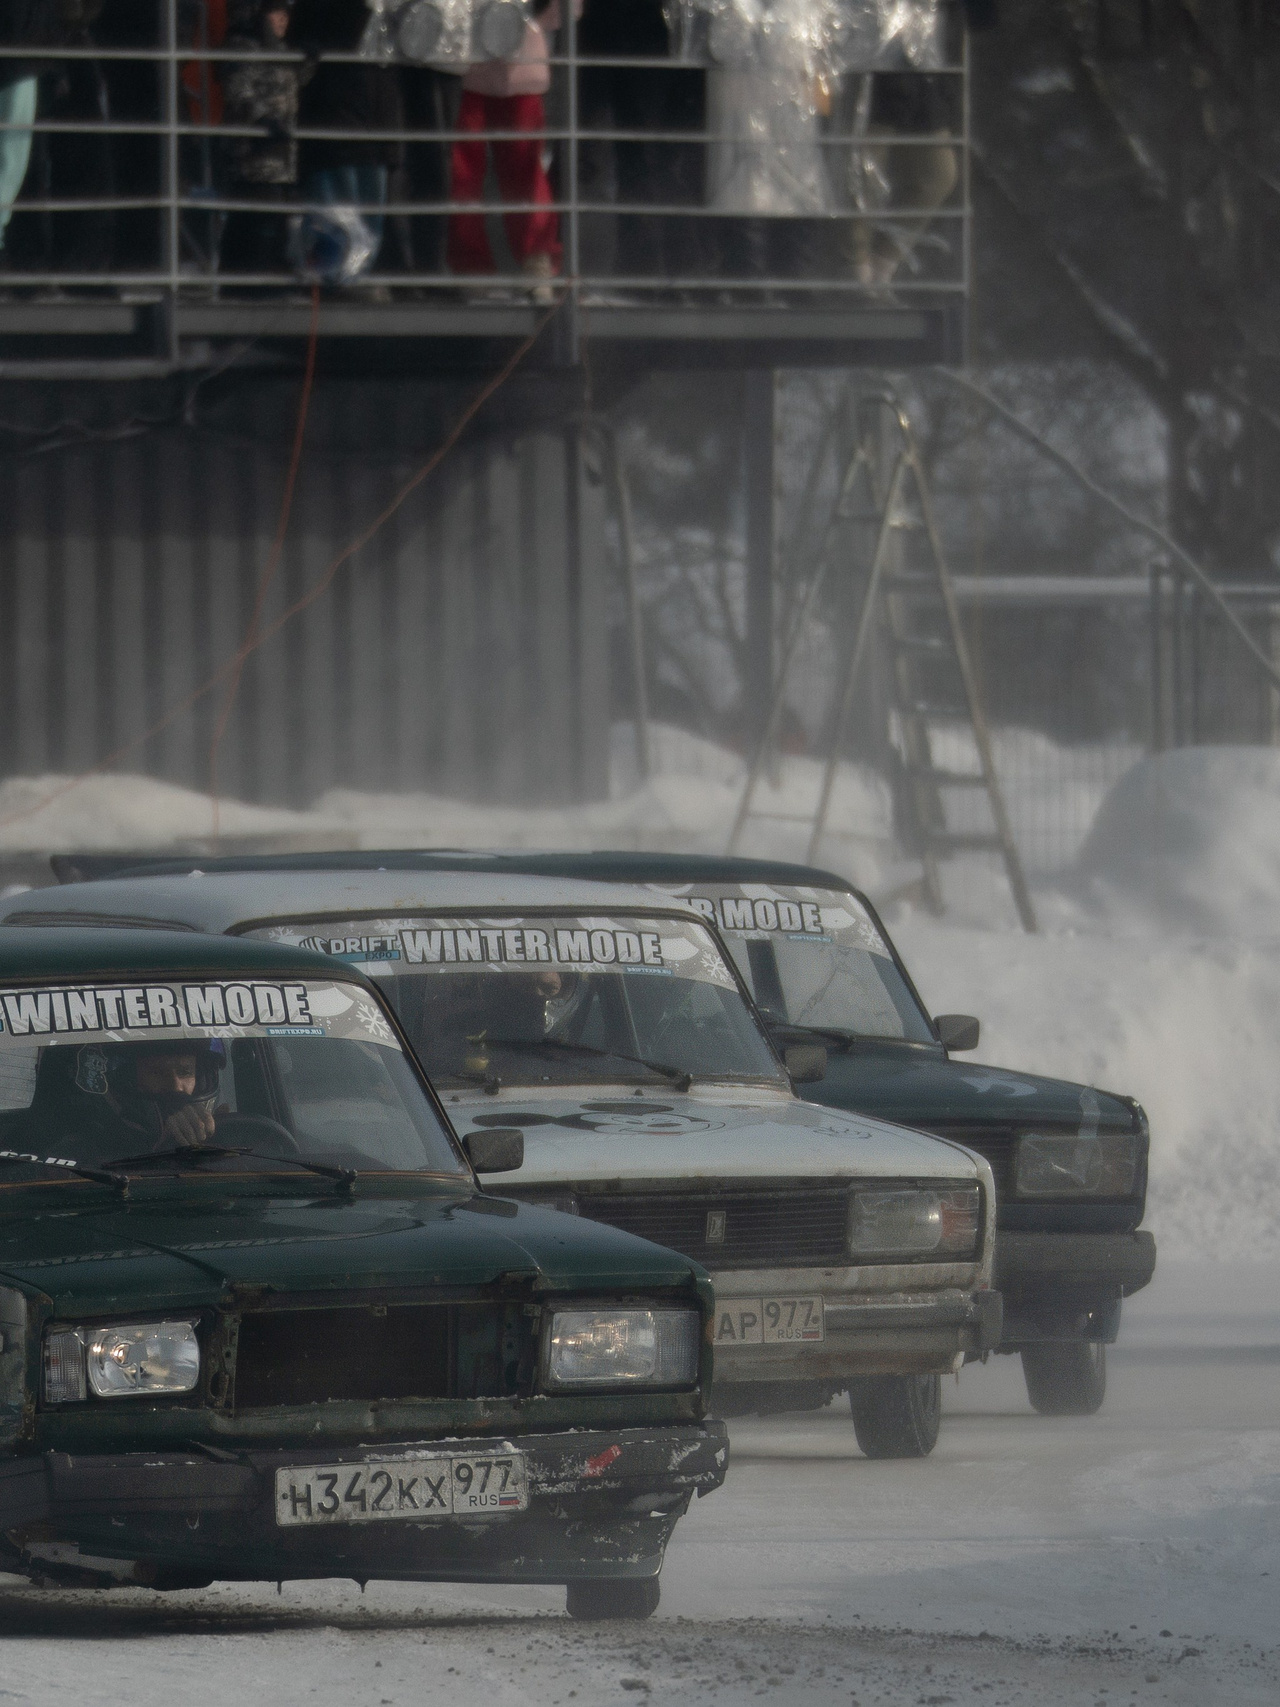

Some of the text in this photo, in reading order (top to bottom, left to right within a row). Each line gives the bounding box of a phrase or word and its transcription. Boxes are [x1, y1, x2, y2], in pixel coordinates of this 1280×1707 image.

[720, 897, 823, 934] MODE
[330, 935, 398, 955] DRIFT
[365, 951, 393, 960] EXPO
[400, 928, 664, 966] WINTER MODE
[1, 984, 313, 1036] WINTER MODE
[269, 1027, 322, 1036] DRIFTEXPO.RU
[765, 1301, 814, 1328] 977
[777, 1328, 801, 1339] RUS
[455, 1459, 513, 1494] 977
[469, 1494, 498, 1506] RUS
